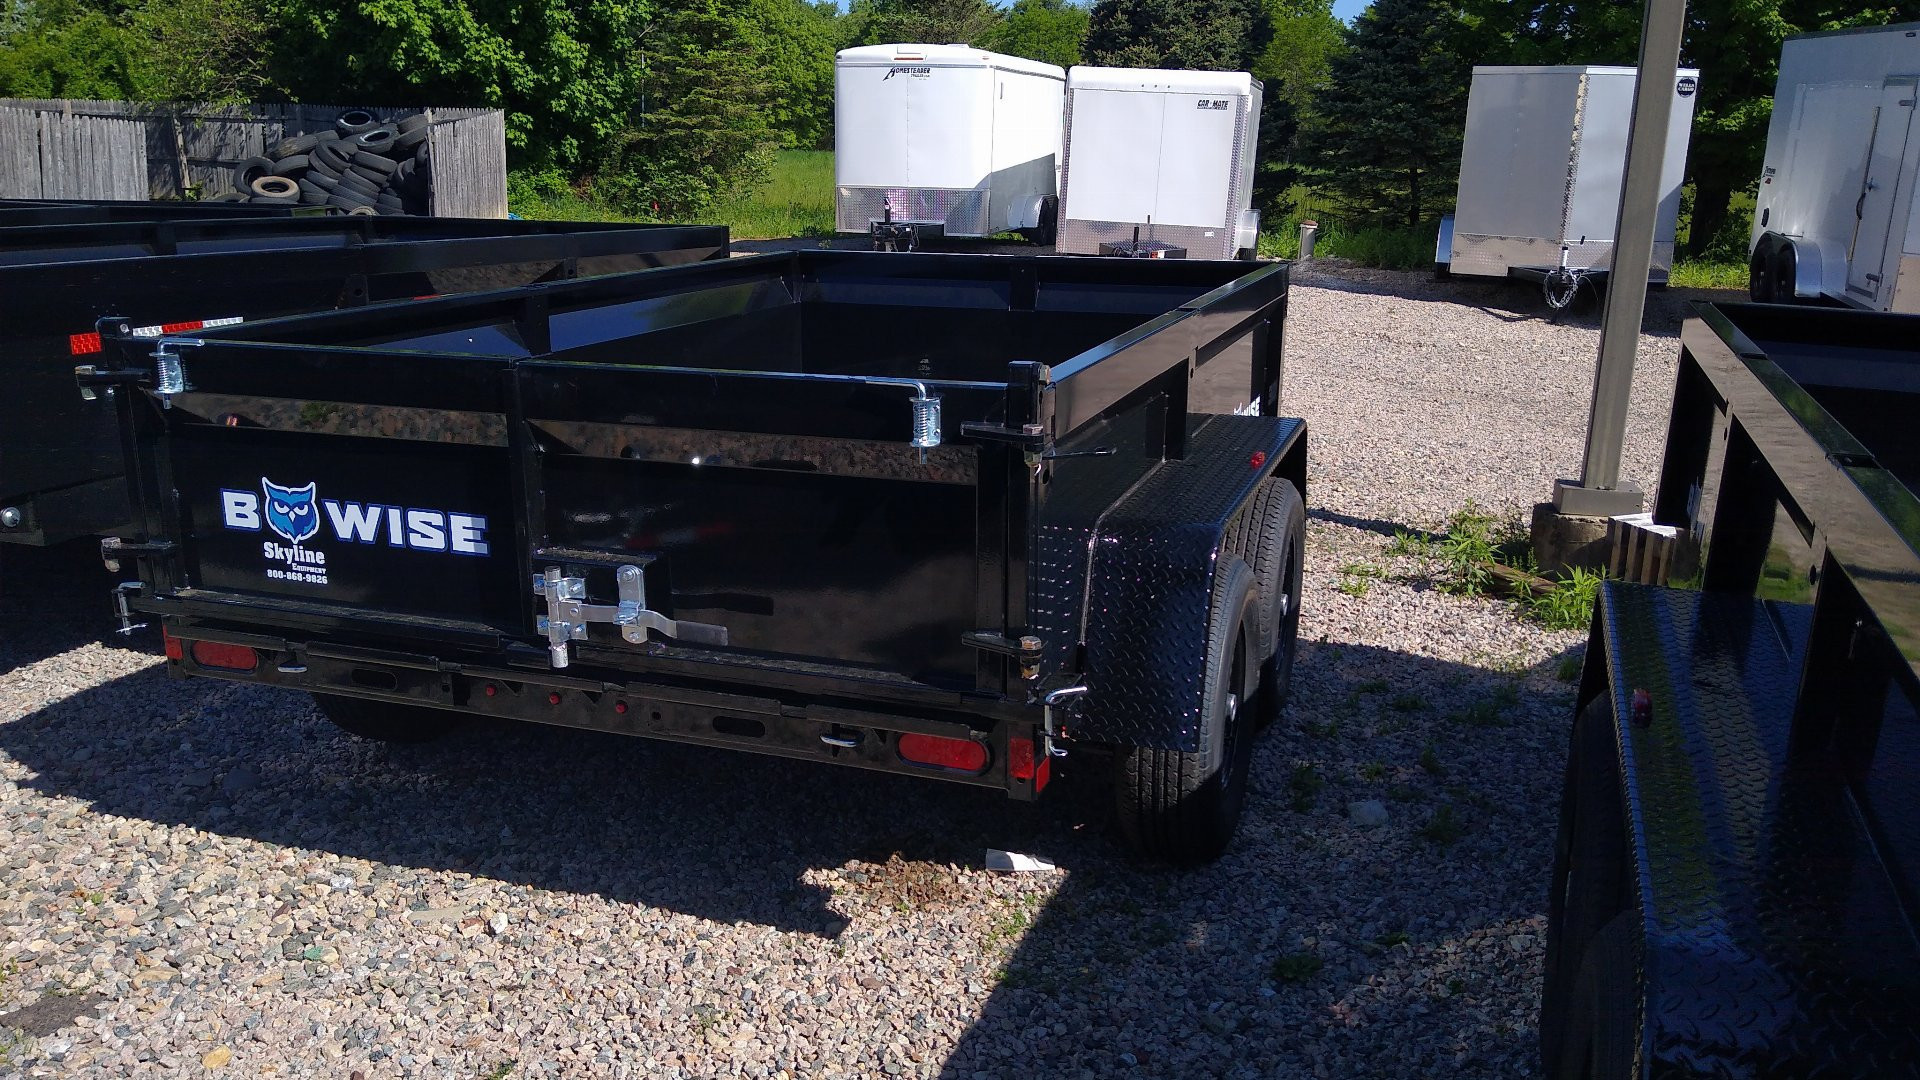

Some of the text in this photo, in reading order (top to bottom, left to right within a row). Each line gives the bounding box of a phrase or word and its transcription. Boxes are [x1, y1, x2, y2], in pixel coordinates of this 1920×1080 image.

[883, 67, 930, 81] HOMESTEADER
[263, 541, 326, 565] Skyline
[266, 568, 329, 585] 800-868-9826
